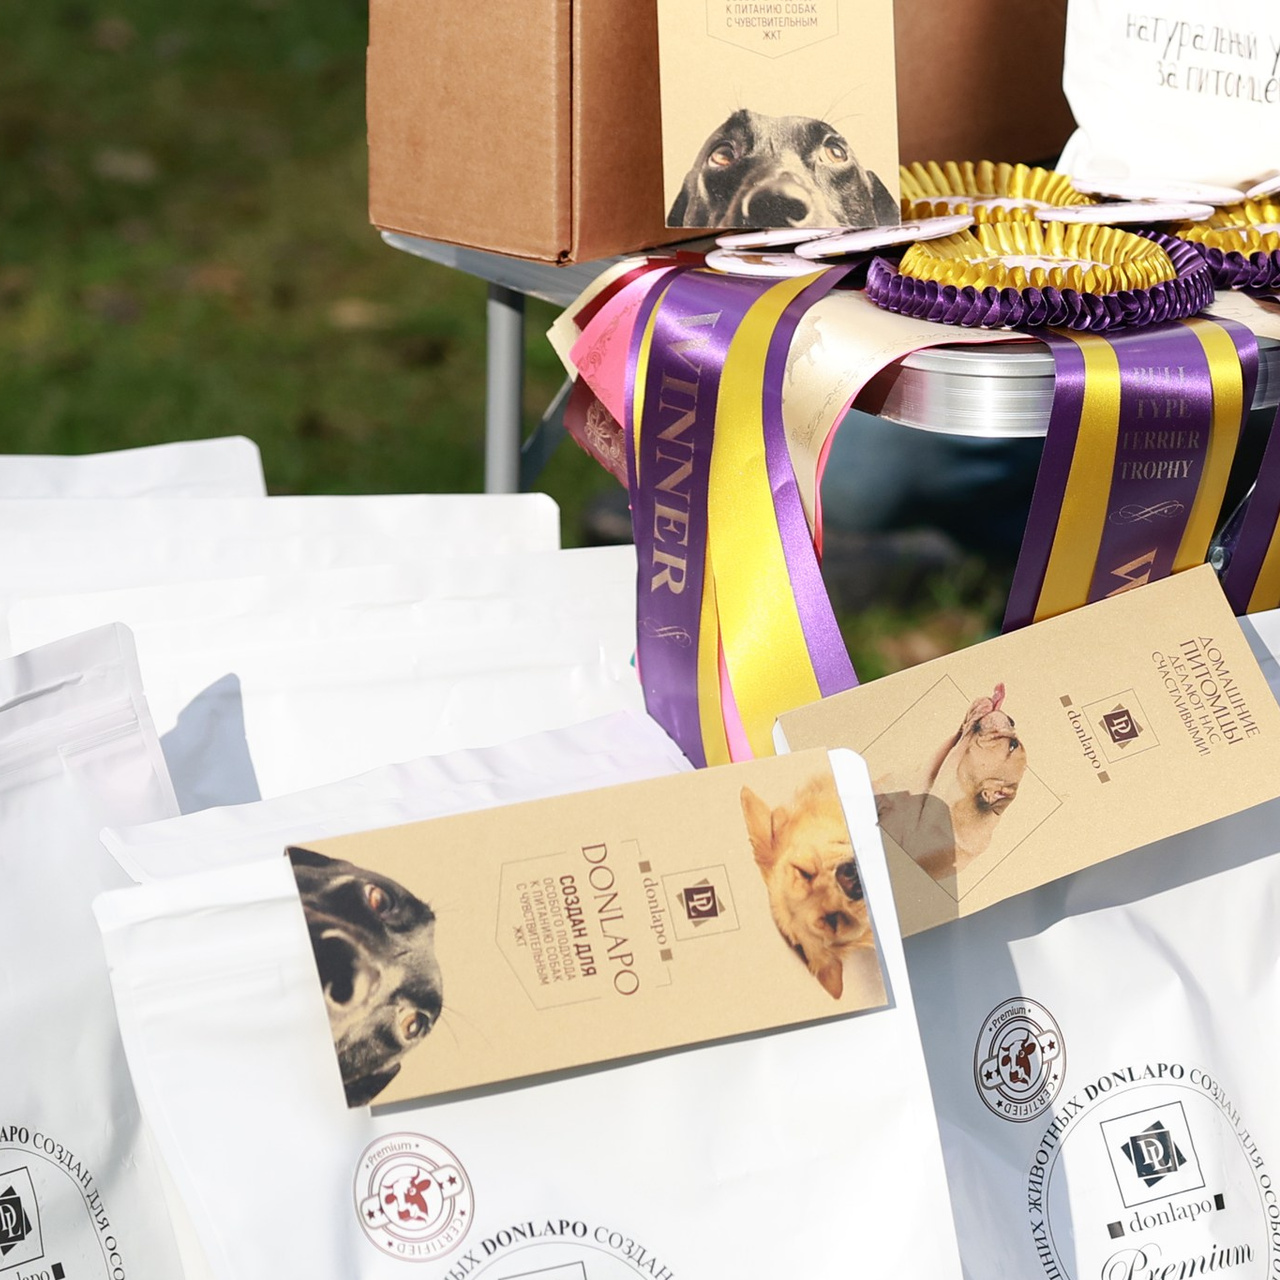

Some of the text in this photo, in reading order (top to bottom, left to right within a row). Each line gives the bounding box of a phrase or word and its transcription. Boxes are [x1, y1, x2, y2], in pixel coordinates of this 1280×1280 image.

[726, 4, 817, 14] К ПИТАНИЮ СОБАК
[727, 17, 818, 27] С ЧУВСТВИТЕЛЬНЫМ
[762, 30, 782, 40] ЖКТ
[1133, 366, 1187, 385] BULL
[1137, 398, 1192, 419] TYPE
[650, 309, 723, 595] WINNER
[1122, 430, 1200, 450] TERRIER
[1120, 460, 1194, 480] TROPHY
[1151, 651, 1211, 757] СЧАСТЛИВЫМИ!
[1168, 655, 1222, 745] ДЕЛАЮТ НАС
[1180, 639, 1244, 745] ПИТОМЦЫ
[1198, 636, 1261, 738] ДОМАШНИЕ
[1067, 710, 1101, 769] donlapo
[543, 877, 576, 981] ОСОБОГО ПОДХОДА
[559, 874, 597, 977] СОЗДАН ДЛЯ
[581, 843, 640, 996] DONLAPO
[642, 877, 668, 945] donlapo
[513, 925, 527, 947] ЖКТ
[518, 892, 550, 986] ЧУВСТВИТЕЛЬНЫМ
[531, 890, 552, 943] ПИТАНИЮ
[545, 947, 563, 982] СОБАК
[992, 1006, 1026, 1029] Premium
[1004, 1081, 1056, 1116] CERTIFIED
[1083, 1062, 1185, 1102] DONLAPO
[1189, 1068, 1241, 1125] СОЗДАН
[368, 1142, 412, 1165] Premium
[1028, 1095, 1086, 1214] ЖИВОТНЫХ
[1238, 1126, 1265, 1170] ДЛЯ
[32, 1132, 93, 1189] СОЗДАН
[86, 1187, 111, 1231] ДЛЯ
[397, 1217, 464, 1256] CERTIFIED
[481, 1218, 589, 1256] DONLAPO
[1128, 1198, 1212, 1234] donlapo
